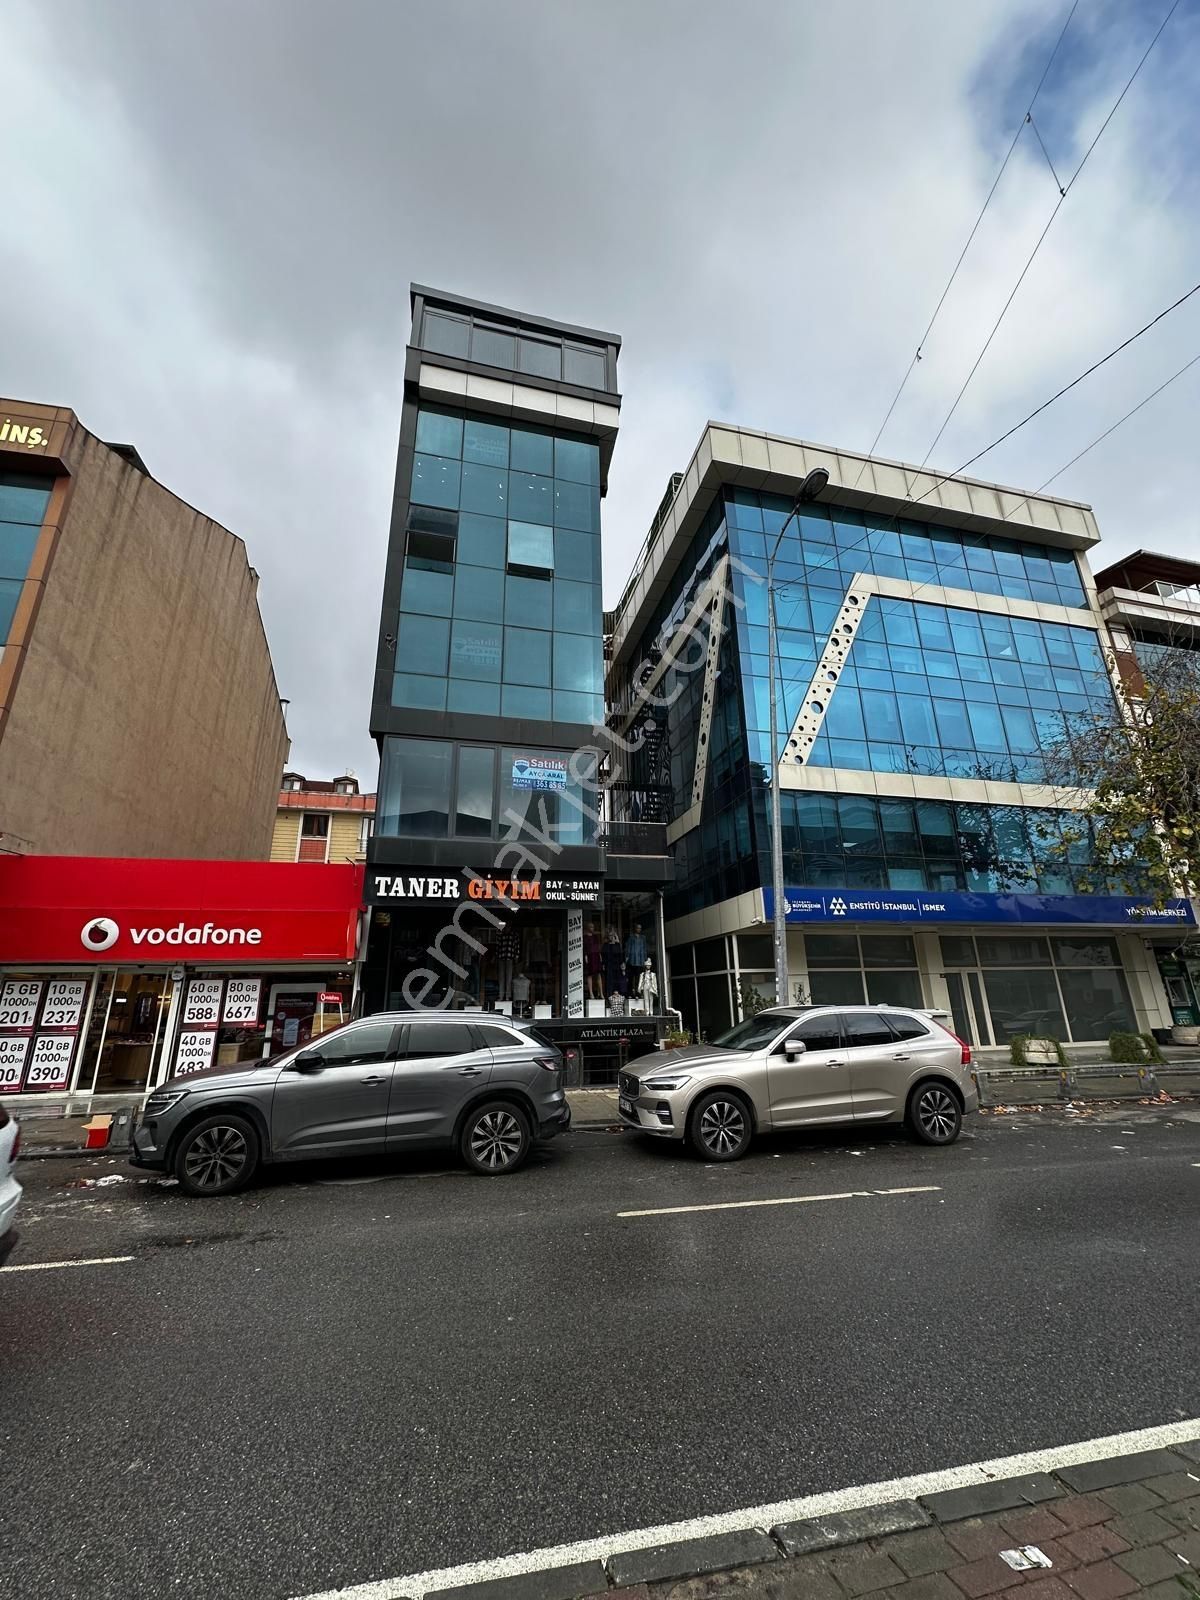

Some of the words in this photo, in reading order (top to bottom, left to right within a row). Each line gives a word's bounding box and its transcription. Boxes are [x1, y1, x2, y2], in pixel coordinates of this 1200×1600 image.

[0, 419, 48, 448] İNŞ.
[530, 759, 564, 770] Satılık
[375, 876, 460, 898] TANER
[468, 873, 541, 900] GİYİM
[546, 881, 563, 890] BAY
[572, 881, 600, 891] BAYAN
[850, 901, 880, 910] ENSTİTÜ
[882, 901, 917, 911] İSTANBUL
[568, 916, 582, 928] BAY
[130, 923, 262, 945] vodafone
[18, 984, 39, 995] GB
[52, 984, 67, 995] 10
[69, 987, 82, 995] GB
[191, 983, 205, 993] 60
[207, 985, 219, 993] GB
[229, 982, 243, 992] 80
[246, 984, 257, 992] GB
[581, 1028, 618, 1038] ATLANTİK
[620, 1028, 644, 1036] PLAZA
[37, 1040, 54, 1051] 30
[56, 1043, 69, 1051] GB
[182, 1035, 196, 1046] 40
[199, 1038, 211, 1046] GB
[10, 1043, 24, 1052] GB
